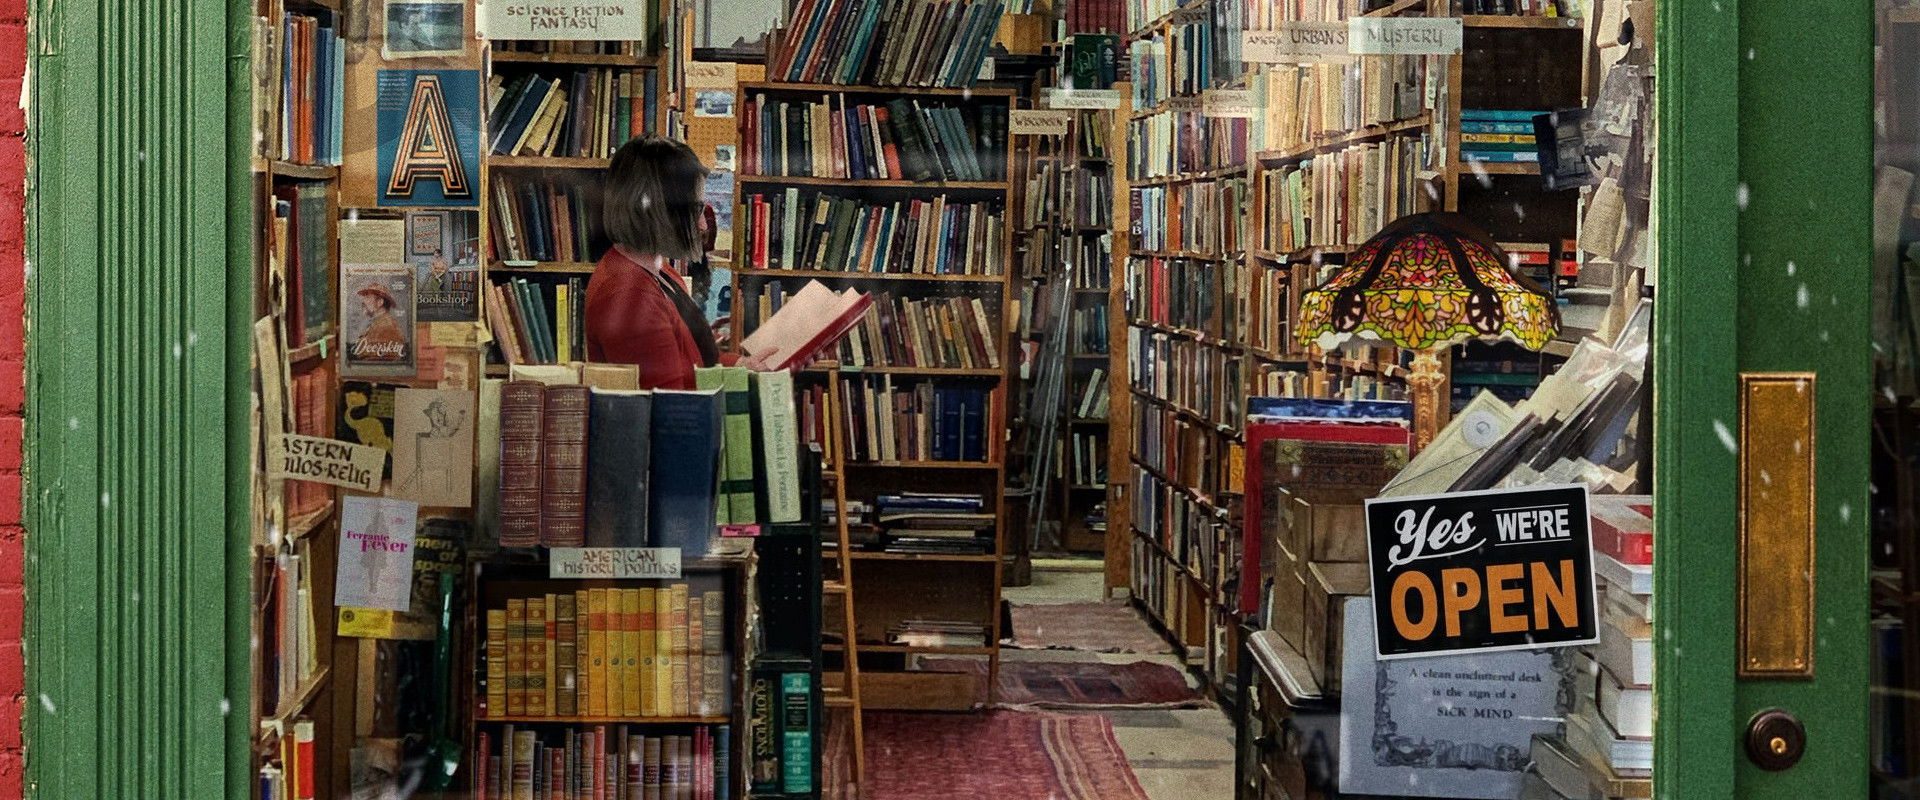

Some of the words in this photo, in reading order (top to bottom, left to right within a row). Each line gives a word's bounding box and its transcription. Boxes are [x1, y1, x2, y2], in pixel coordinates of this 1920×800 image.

[507, 5, 567, 16] SCIENCE
[574, 6, 624, 17] FICTION
[530, 17, 598, 32] FANTASY
[1291, 28, 1334, 45] URBAN
[1367, 27, 1443, 48] MYSTERY
[417, 293, 468, 306] Bookshop
[351, 338, 406, 357] Deerskin
[346, 529, 391, 541] Ferrante
[1387, 505, 1487, 572] Yes
[1495, 508, 1571, 542] WE'RE
[361, 540, 409, 553] Fever
[583, 549, 655, 563] AMERICAN
[1390, 559, 1579, 641] OPEN
[1409, 668, 1418, 678] A
[1422, 668, 1451, 679] clean
[1455, 670, 1515, 682] uncluttered
[1518, 672, 1542, 682] desk
[1432, 687, 1441, 696] is
[1446, 686, 1462, 697] the
[1468, 689, 1491, 700] sign
[1495, 688, 1506, 699] of
[1437, 706, 1467, 717] SICK
[1473, 707, 1513, 719] MIND
